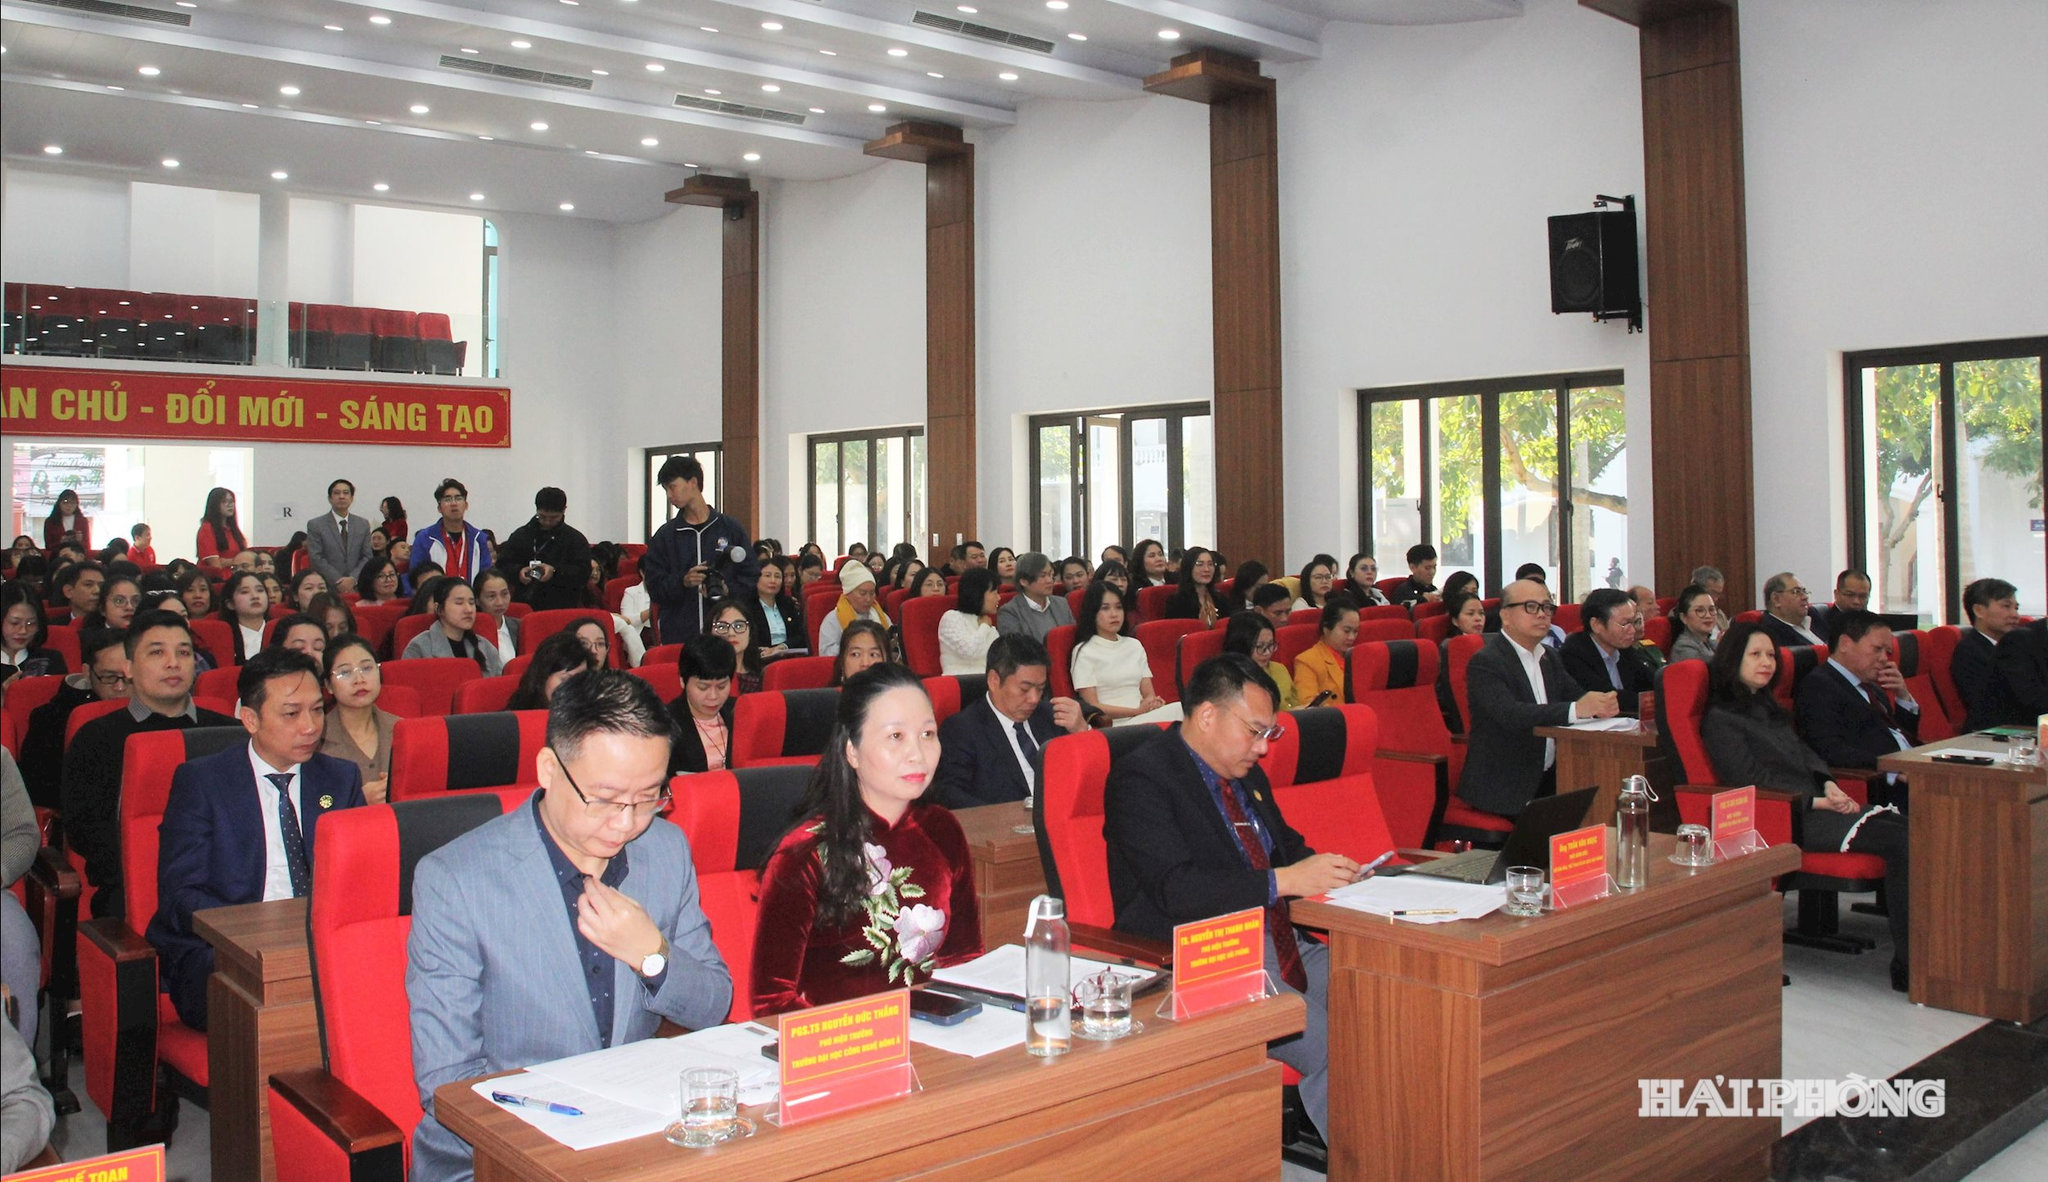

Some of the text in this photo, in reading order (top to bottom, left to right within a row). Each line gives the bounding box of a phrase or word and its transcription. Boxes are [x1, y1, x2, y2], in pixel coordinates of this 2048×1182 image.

[51, 381, 127, 421] CHỦ
[166, 381, 226, 425] ĐỔI
[239, 390, 304, 427] MỚI
[340, 396, 427, 431] SÁNG
[437, 404, 494, 439] TẠO
[283, 507, 293, 518] R
[791, 1023, 820, 1038] PGS.TS
[821, 1013, 854, 1031] NGUYỄN
